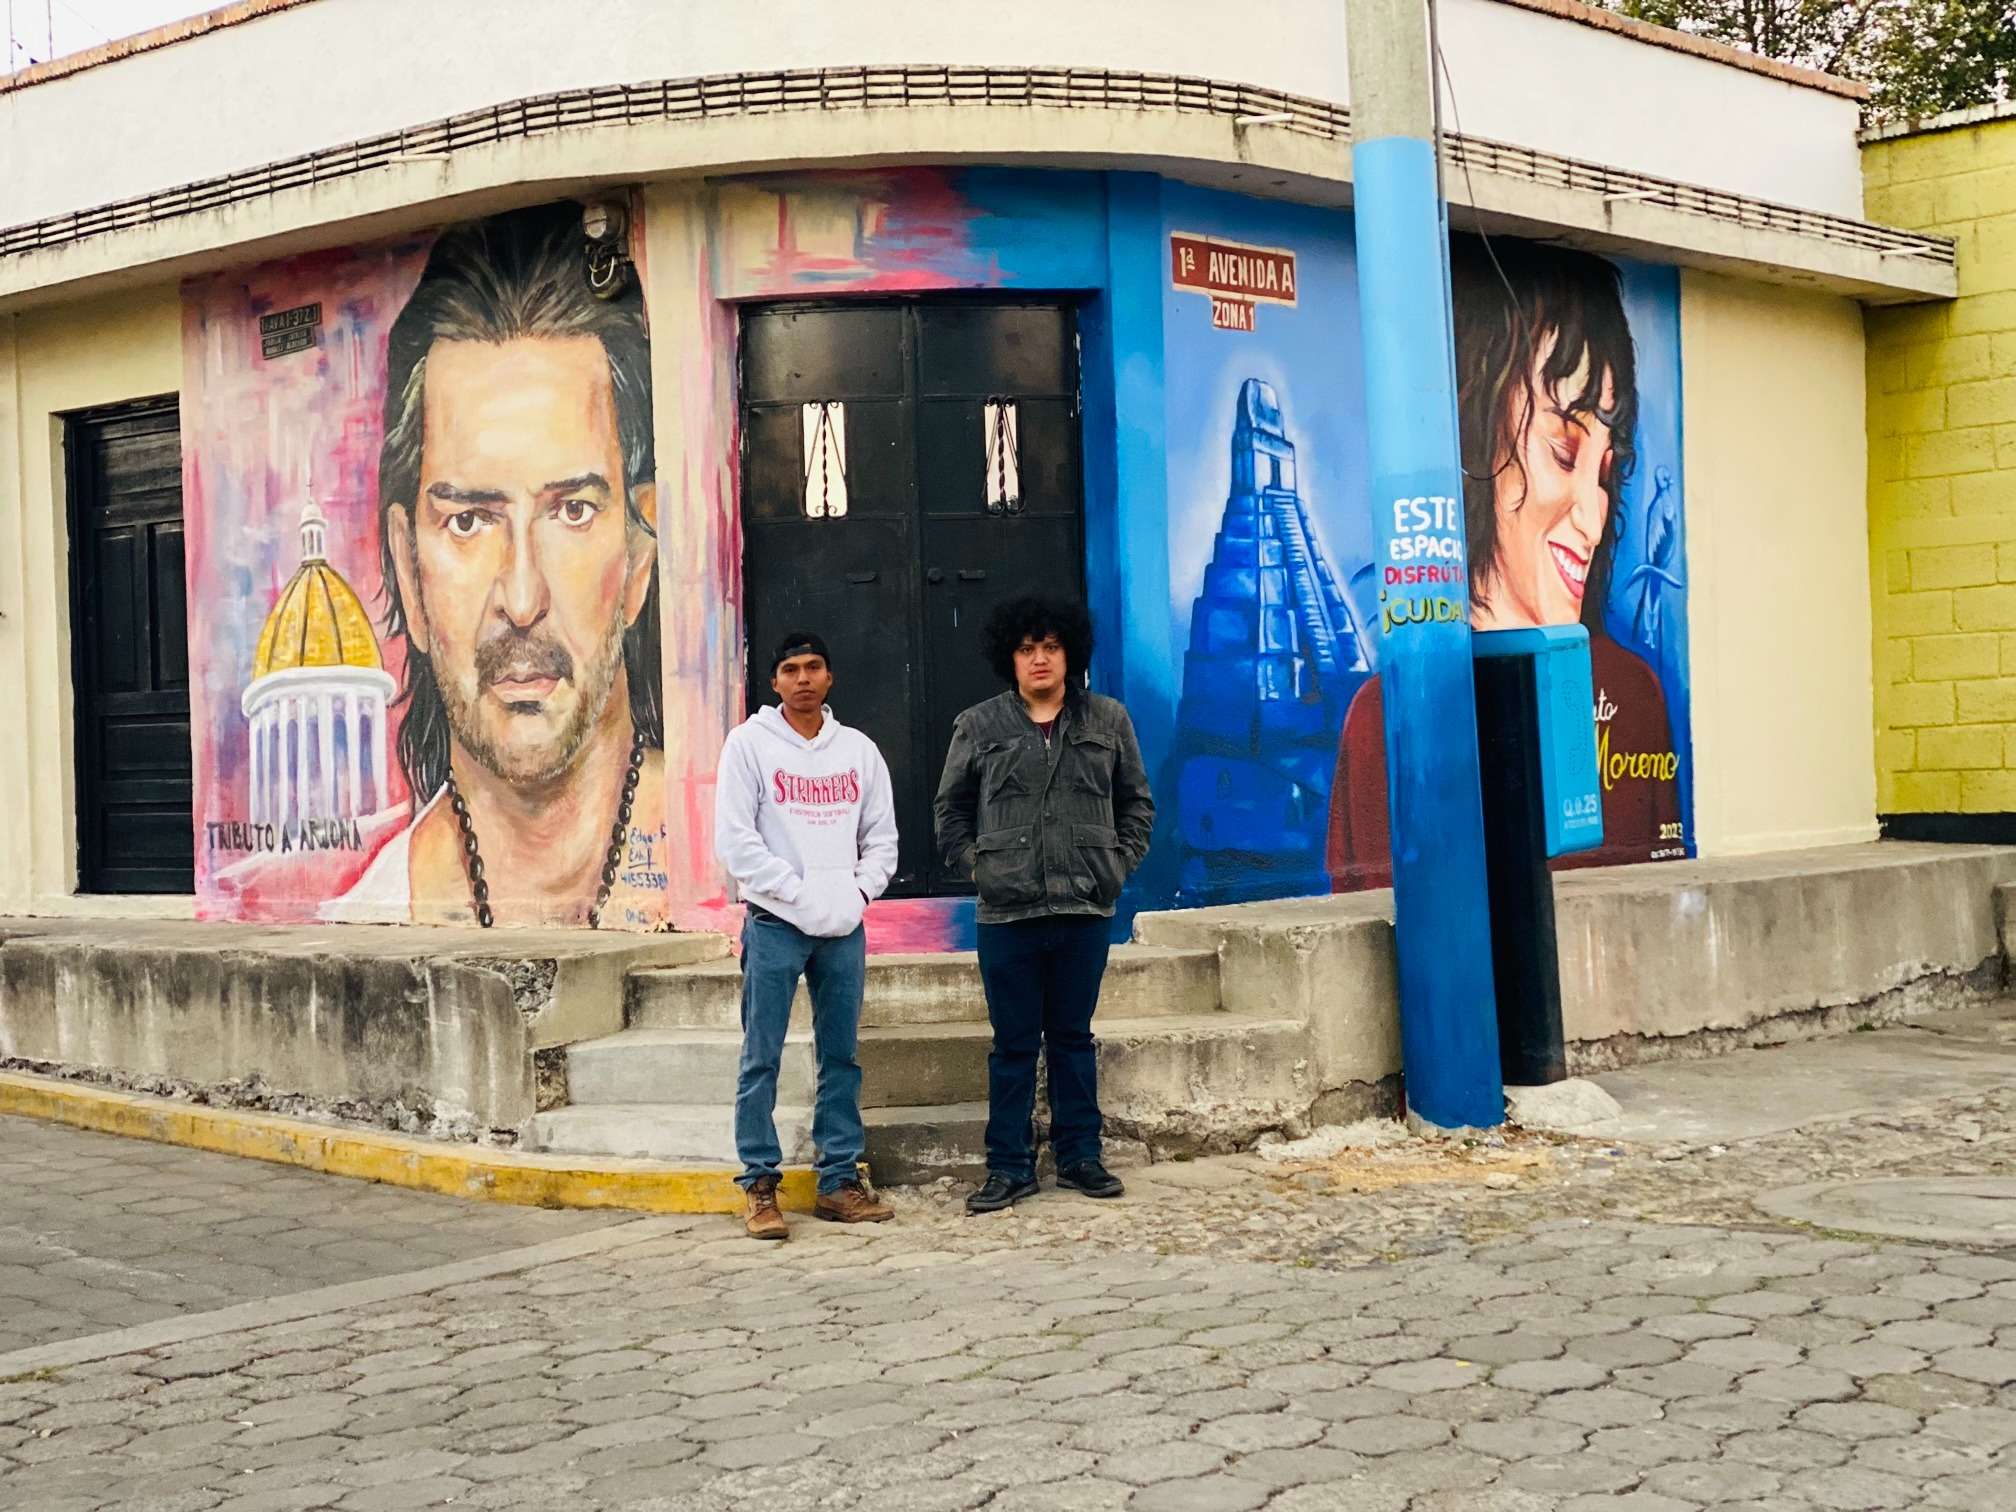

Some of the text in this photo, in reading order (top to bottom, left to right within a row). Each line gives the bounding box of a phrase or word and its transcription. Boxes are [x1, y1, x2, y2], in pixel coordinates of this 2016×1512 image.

[1208, 251, 1278, 291] AVENIDA
[1281, 263, 1294, 293] A
[1213, 302, 1255, 331] ZONA 1
[1393, 496, 1457, 534] ESTE
[206, 819, 364, 854] TRIBUTO A ARJONA
[1659, 822, 1683, 840] 2023
